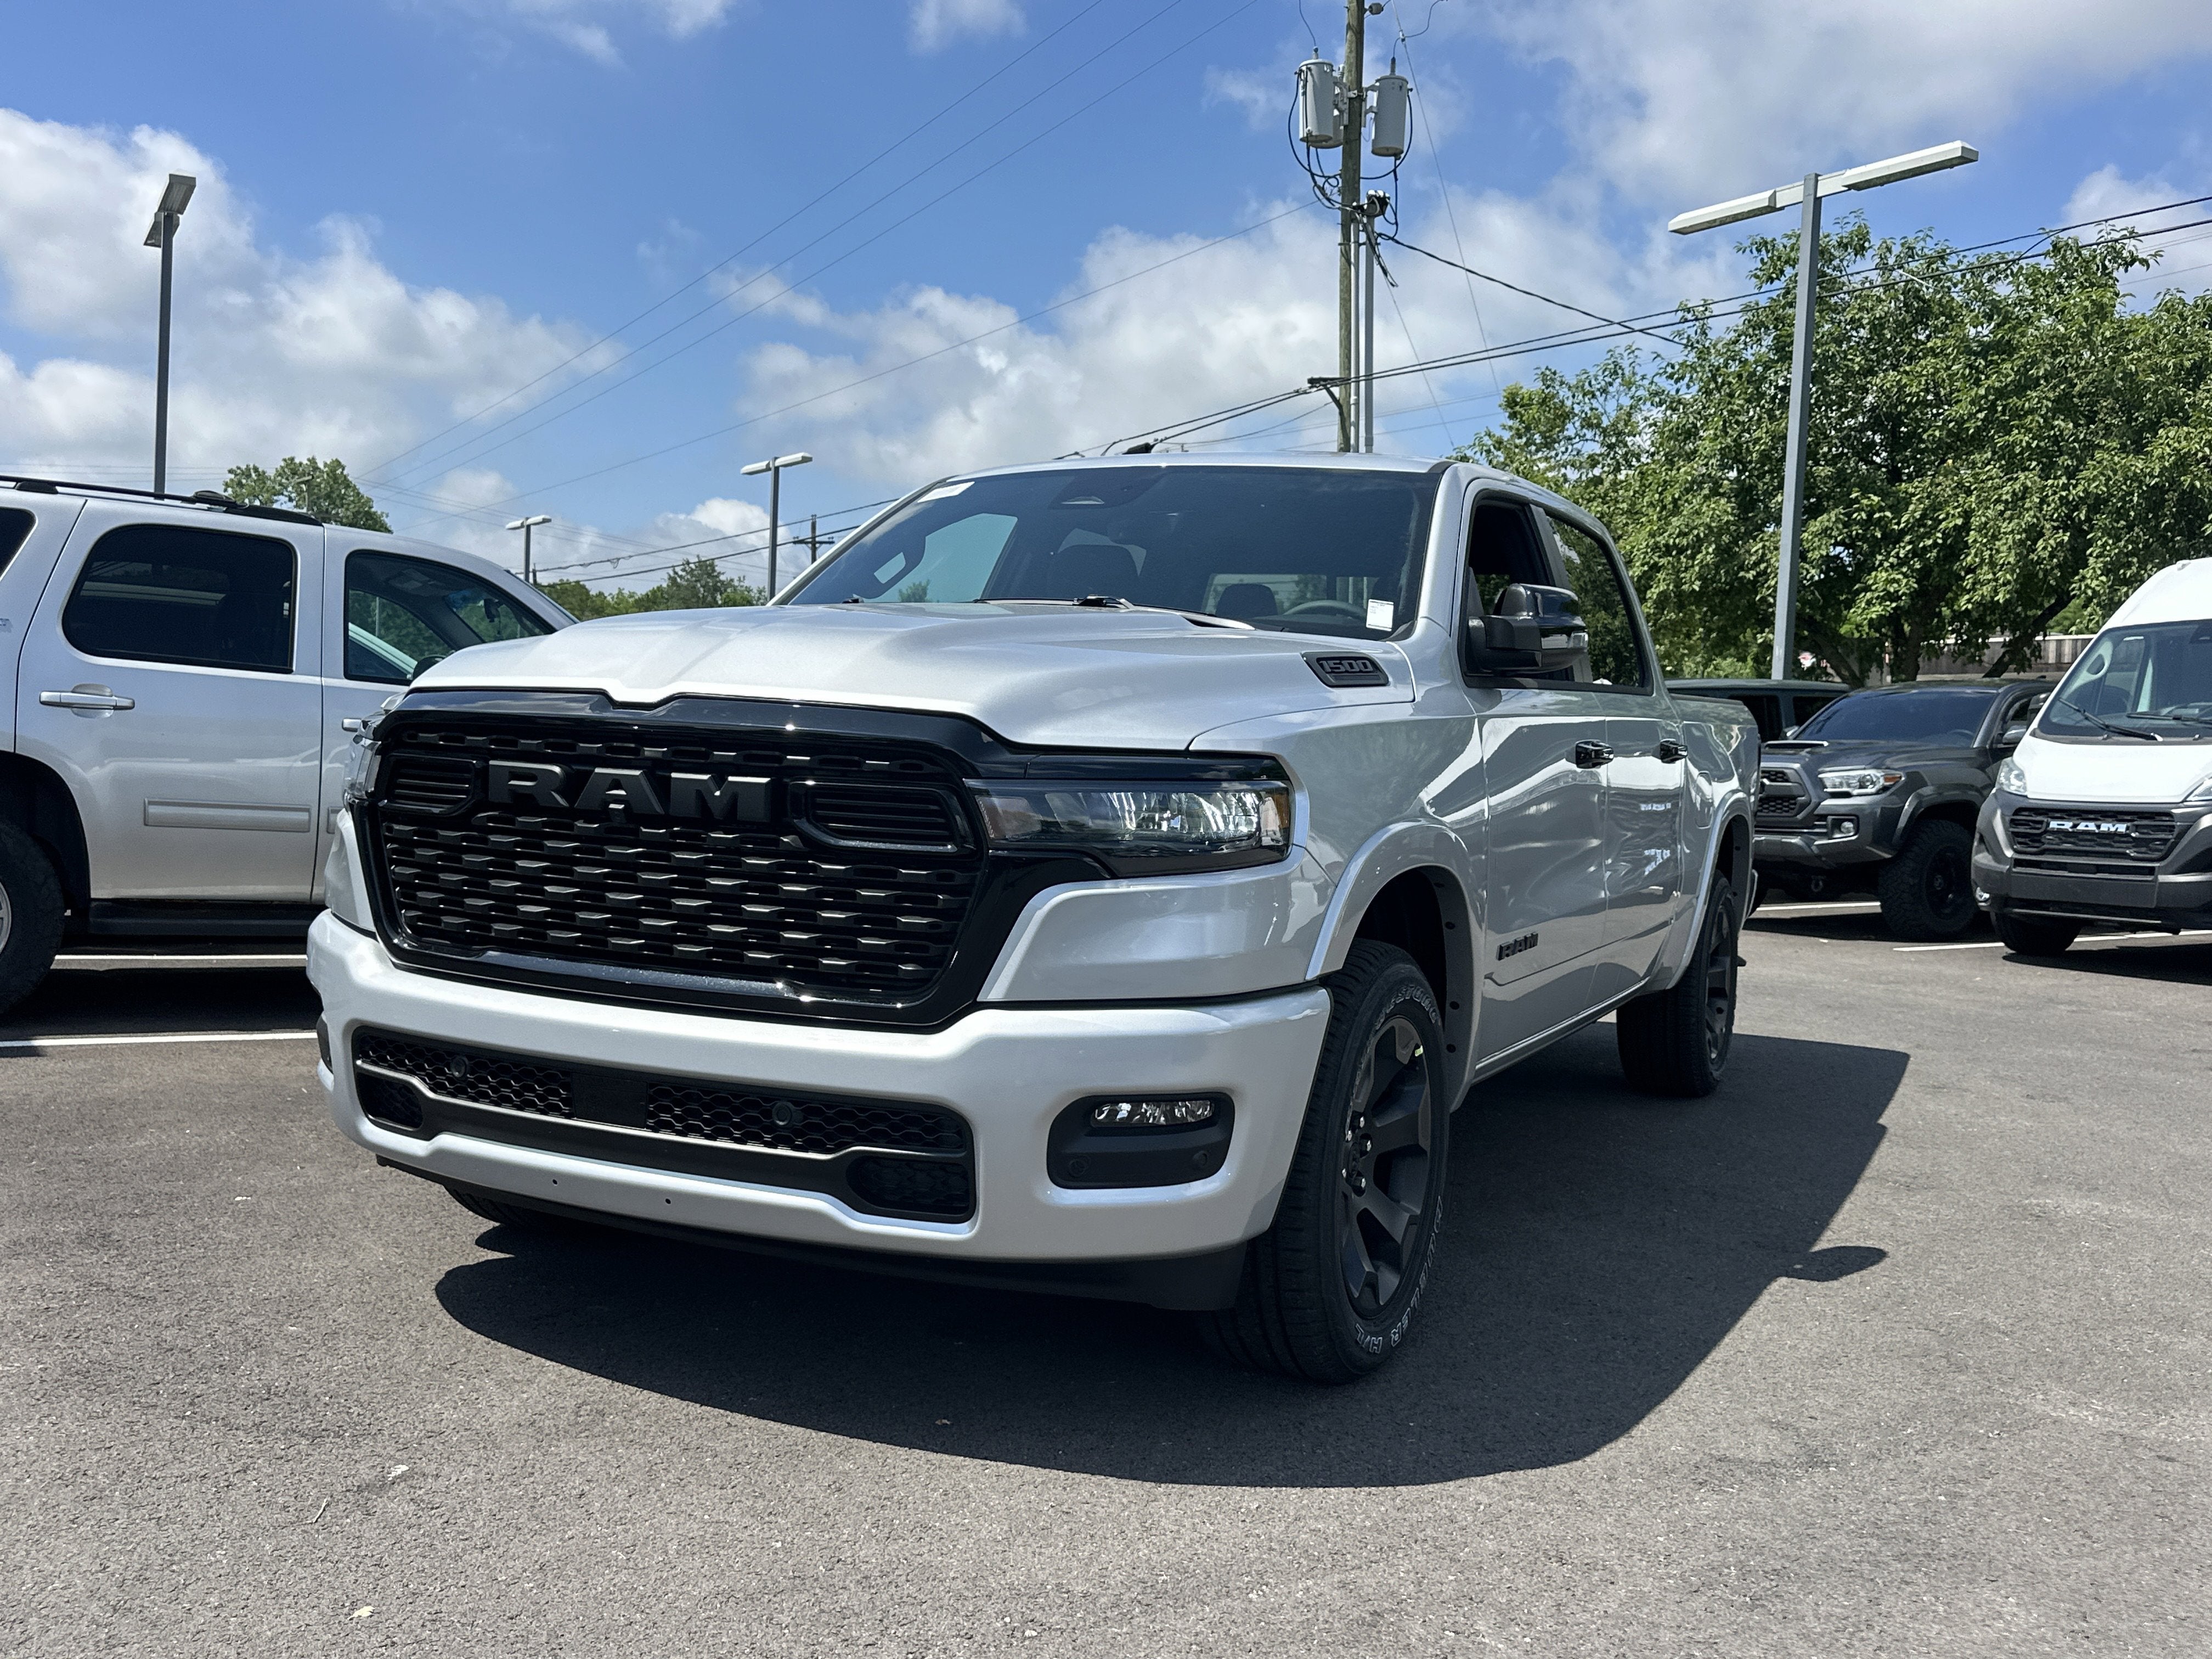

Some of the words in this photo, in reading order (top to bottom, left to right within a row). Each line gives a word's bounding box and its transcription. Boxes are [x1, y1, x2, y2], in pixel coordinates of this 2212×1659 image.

[1319, 659, 1373, 673] 1500
[489, 760, 771, 822] RAM
[2049, 821, 2128, 833] RAM
[1497, 932, 1539, 961] RAM
[1356, 1323, 1383, 1354] H/L
